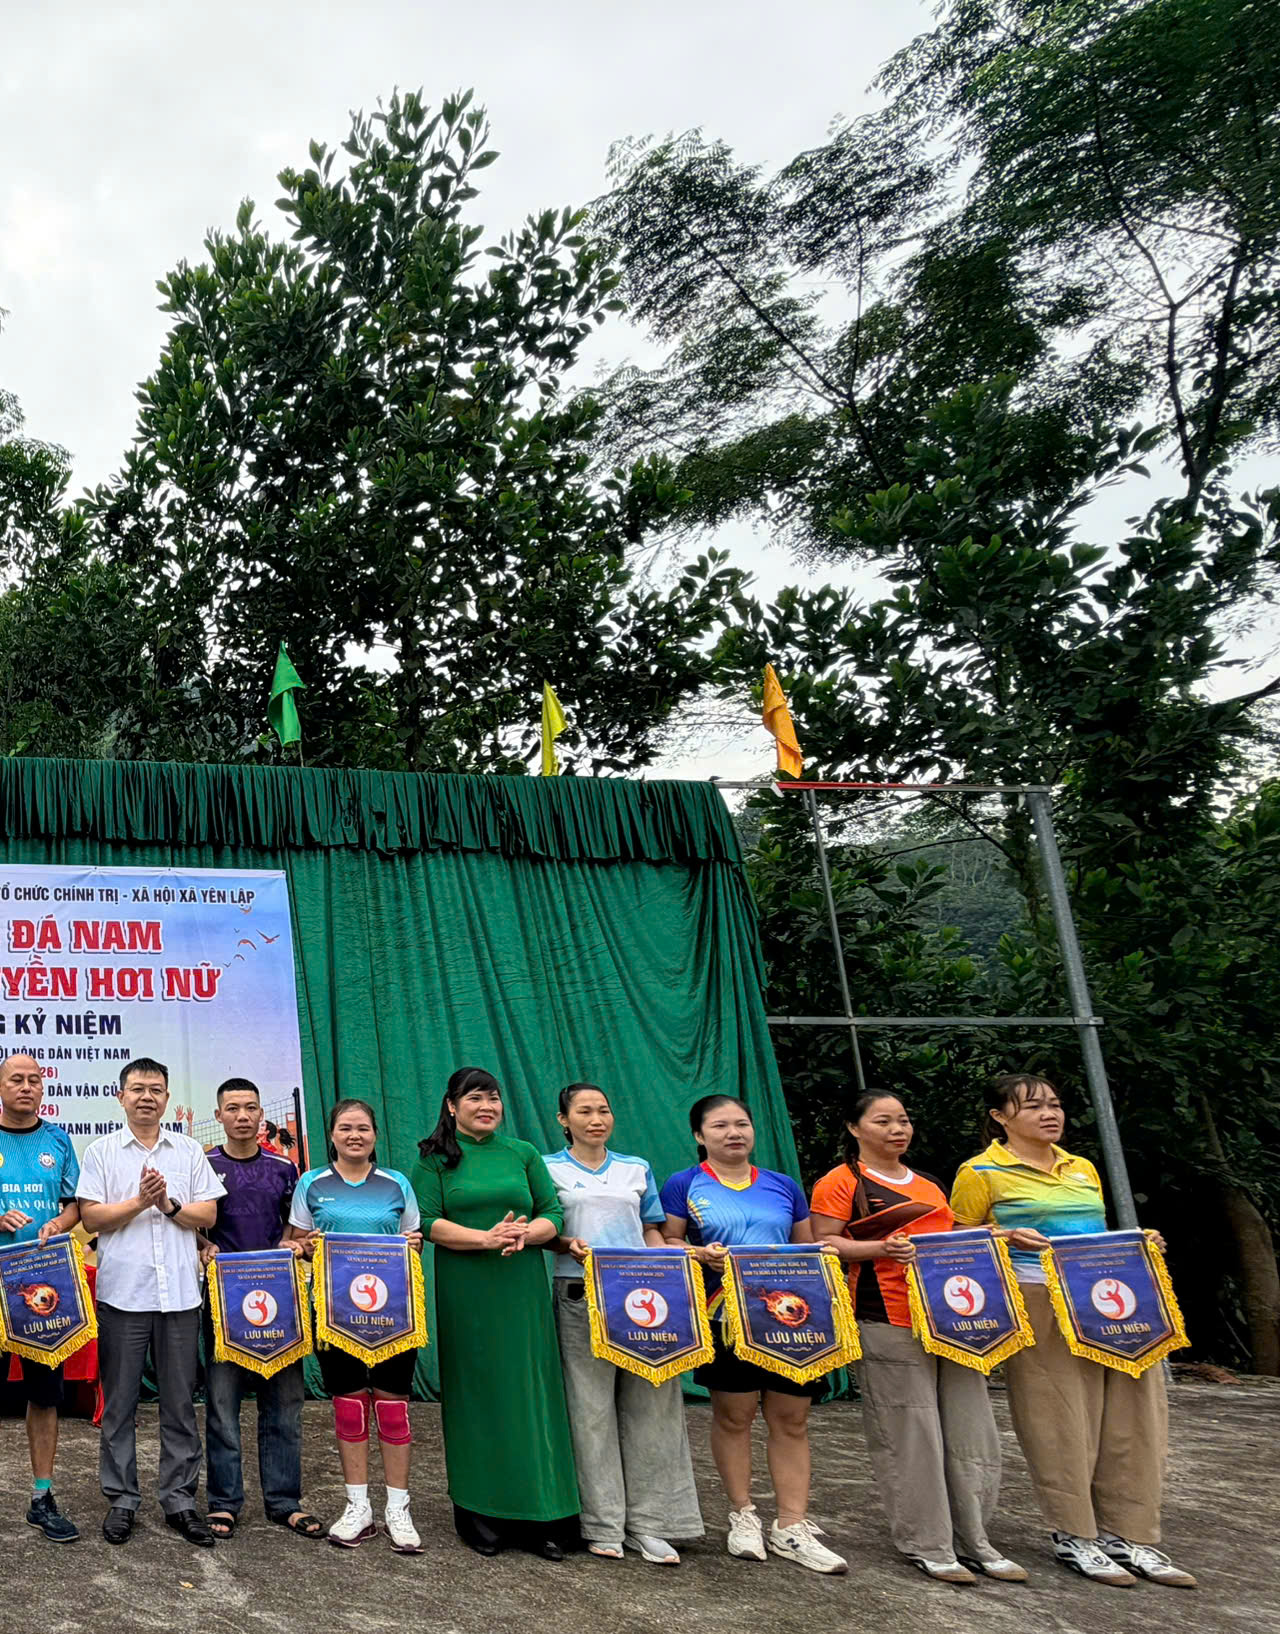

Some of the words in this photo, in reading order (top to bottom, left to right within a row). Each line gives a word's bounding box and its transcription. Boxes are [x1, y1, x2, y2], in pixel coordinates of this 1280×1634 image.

[14, 884, 50, 901] CHỨC
[54, 884, 94, 902] CHÍNH
[99, 888, 118, 905] TRỊ
[132, 886, 151, 902] XÃ
[154, 887, 175, 905] HỘI
[179, 887, 197, 903] XÃ
[200, 888, 226, 904] YÊN
[231, 888, 255, 905] LẬP
[10, 914, 62, 951] ĐÁ
[72, 919, 162, 952] NAM
[163, 962, 221, 1001] NỮ
[15, 1008, 46, 1035] KỶ
[56, 1010, 122, 1039] NIỆM
[48, 1045, 72, 1060] DÂN
[75, 1045, 100, 1062] VIỆT
[104, 1048, 130, 1060] NAM
[48, 1082, 72, 1097] DÂN
[75, 1082, 99, 1099] VẬN
[103, 1081, 118, 1097] CỦ
[2, 1184, 20, 1193] BIA
[23, 1321, 43, 1335] LƯU
[46, 1315, 71, 1331] NIỆM
[350, 1314, 368, 1325] LƯU
[371, 1314, 394, 1328] NIỆM
[952, 1320, 973, 1332] LƯU
[974, 1317, 999, 1331] NIỆM
[1100, 1324, 1121, 1336] LƯU
[1123, 1321, 1151, 1335] NIỆM
[245, 1329, 261, 1340] LƯU
[263, 1328, 284, 1341] NIỆM
[628, 1330, 648, 1341] LƯU
[651, 1330, 678, 1344] NIỆM
[765, 1331, 790, 1344] LƯU
[793, 1329, 826, 1346] NIỆM
